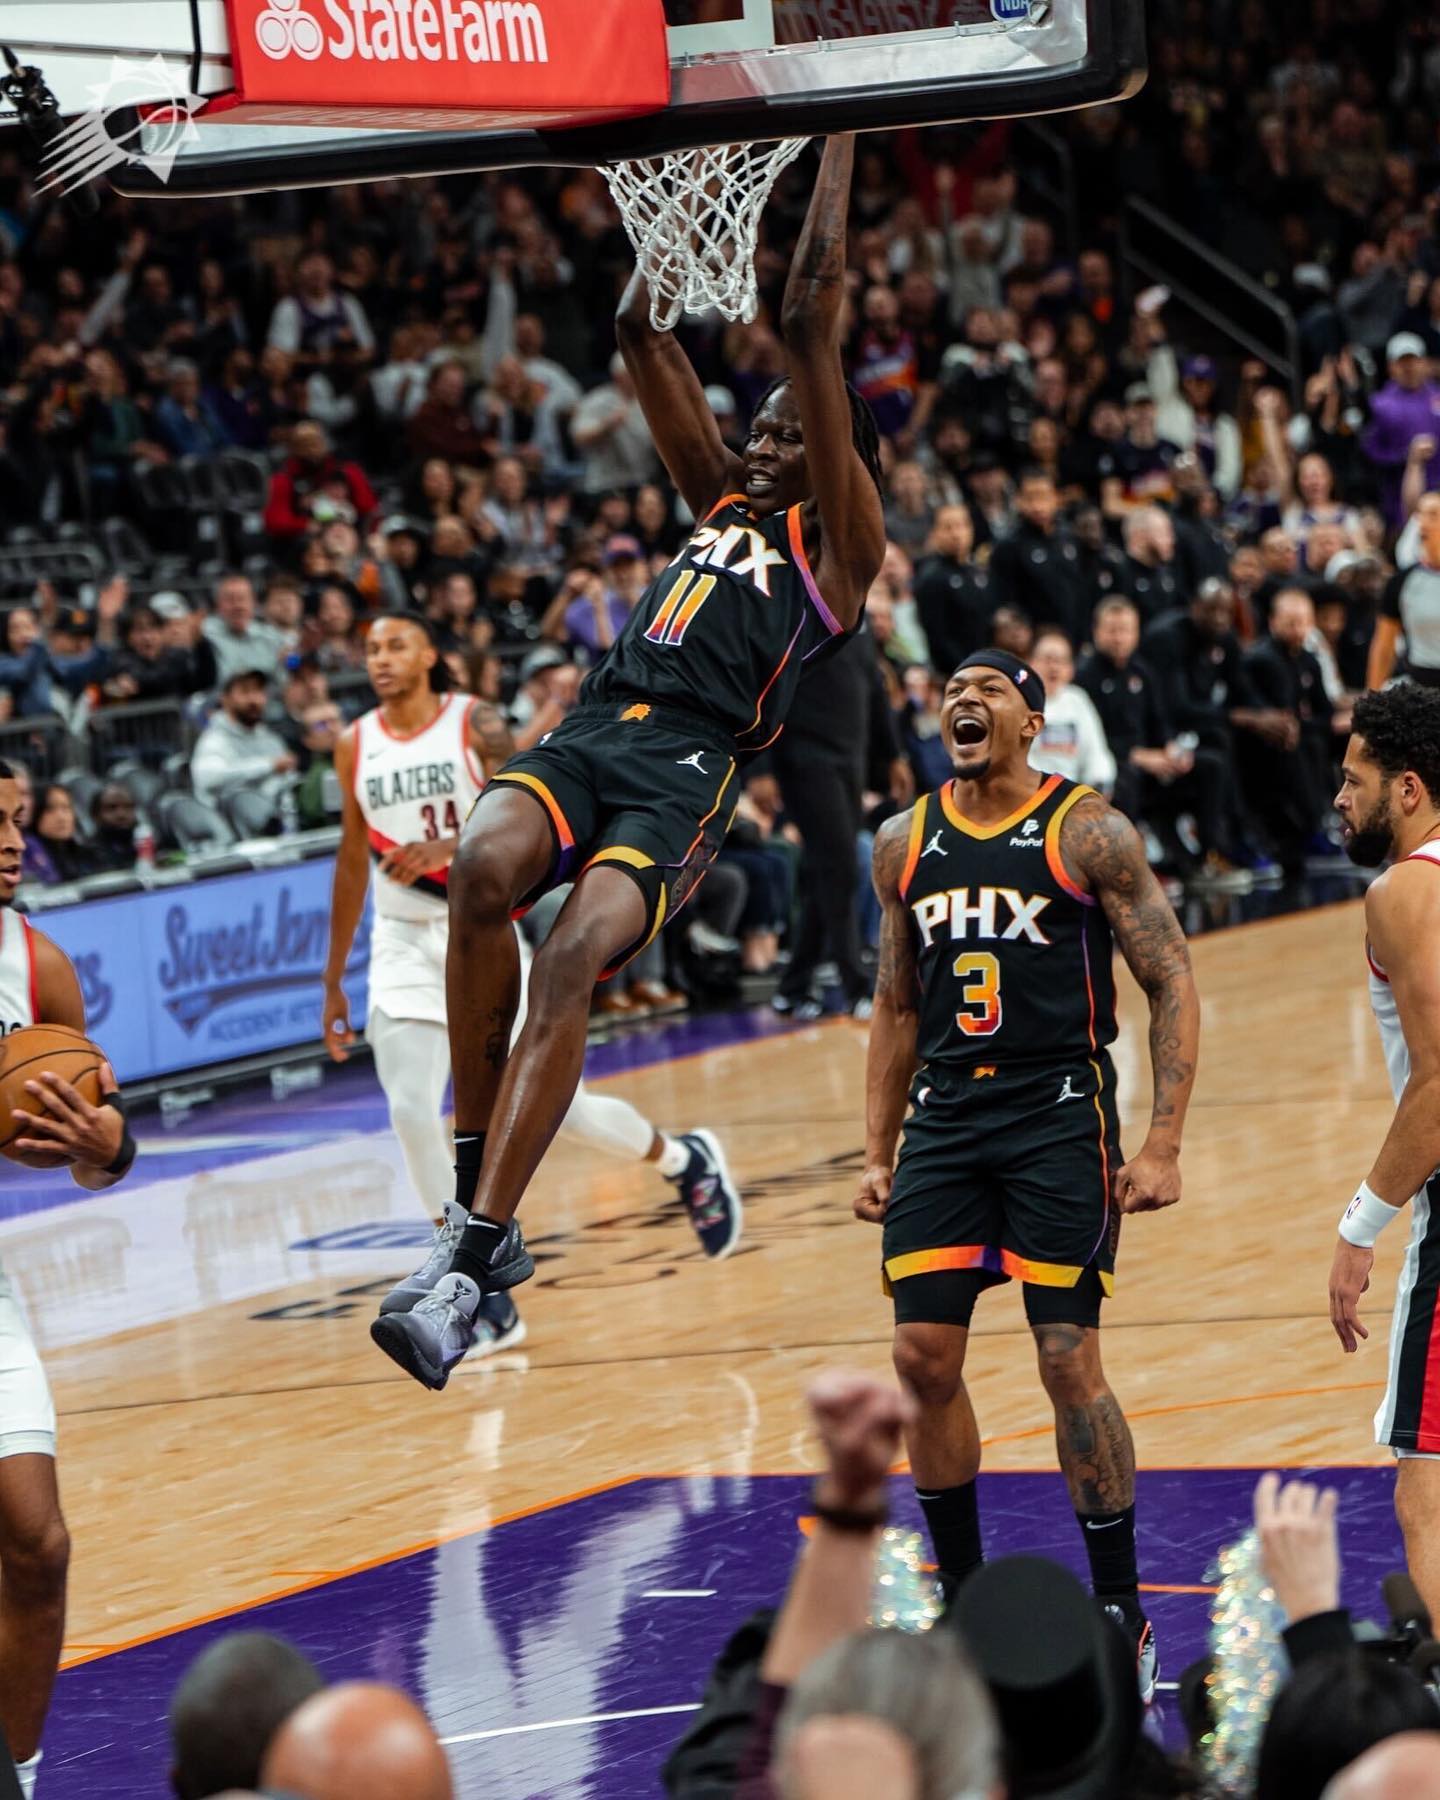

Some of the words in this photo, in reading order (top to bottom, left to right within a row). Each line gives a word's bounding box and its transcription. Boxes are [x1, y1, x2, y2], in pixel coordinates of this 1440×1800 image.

[643, 569, 717, 646] 11
[366, 762, 455, 810] BLAZERS
[421, 800, 460, 842] 34
[1009, 837, 1044, 848] PayPal
[911, 886, 1053, 948] PHX
[952, 952, 1003, 1036] 3
